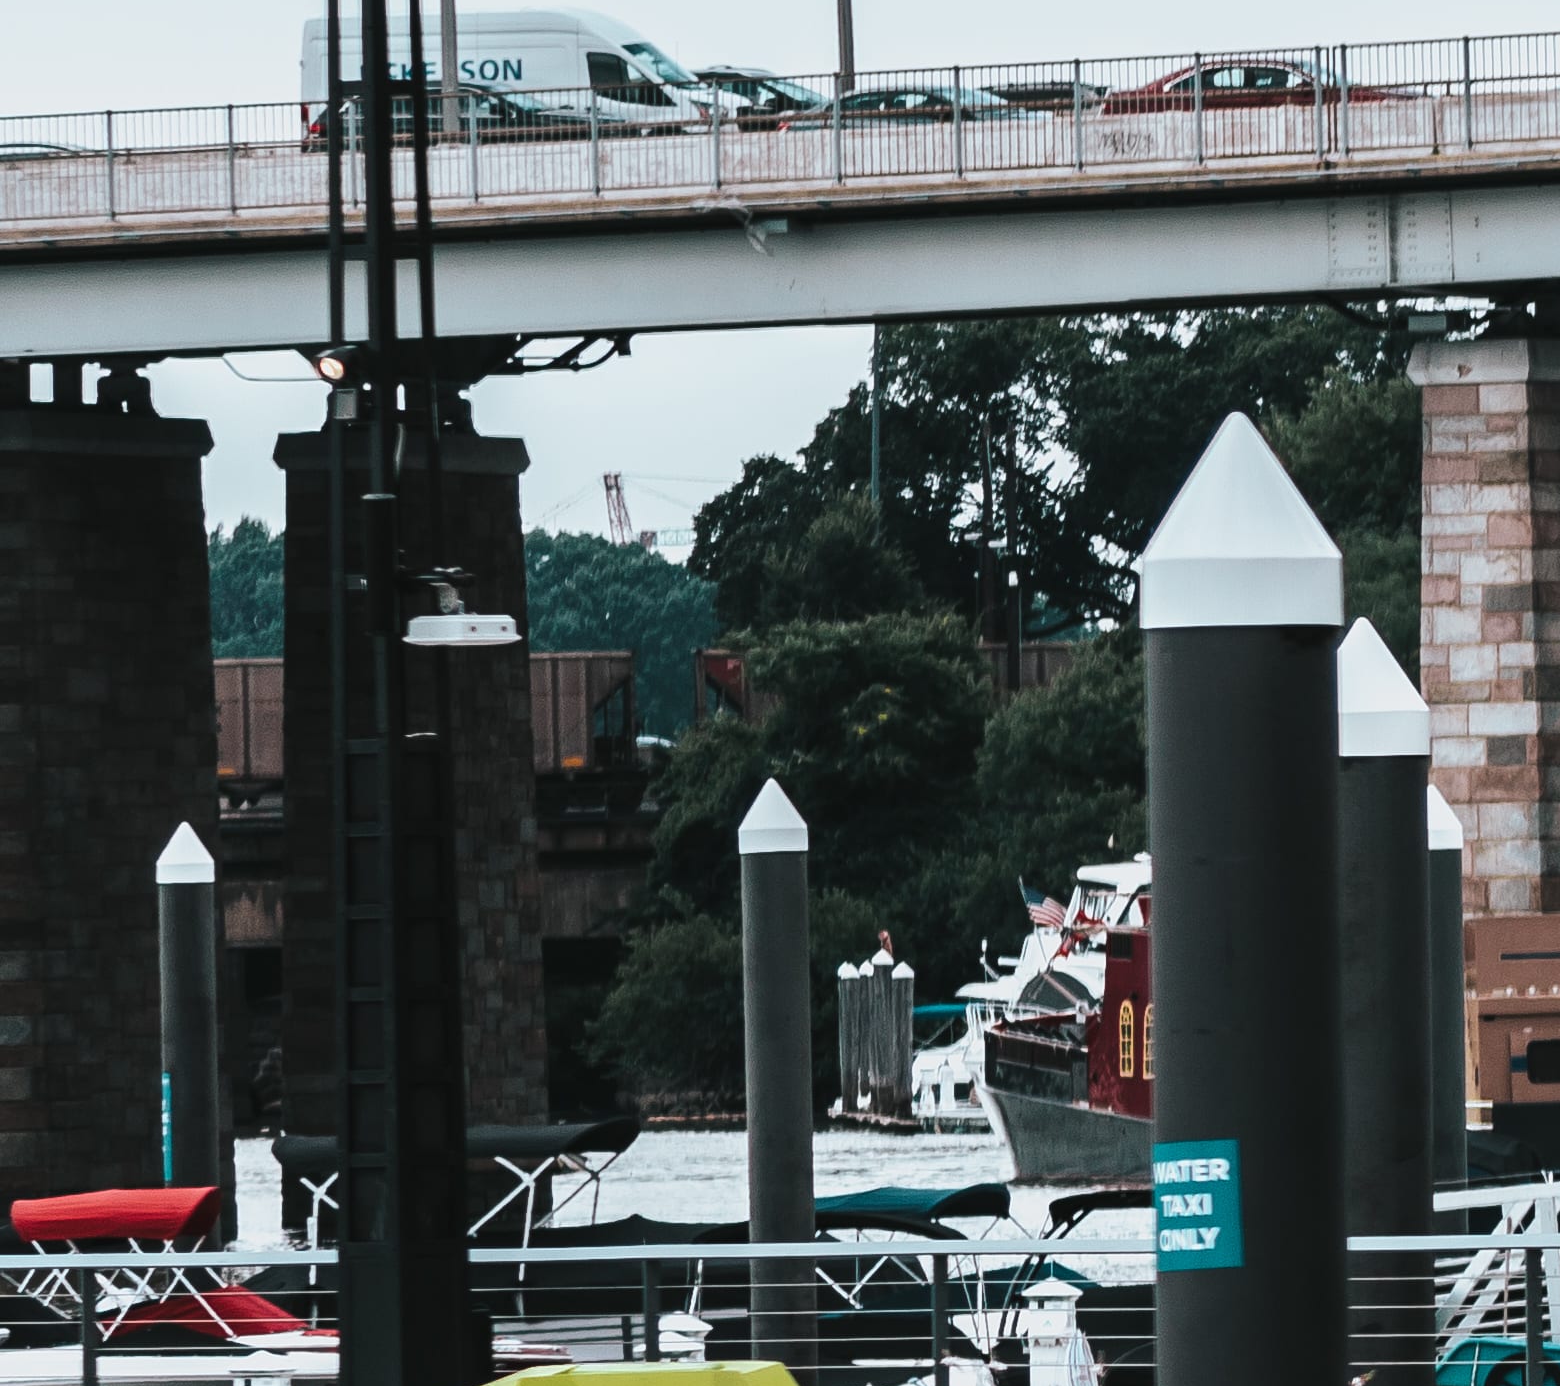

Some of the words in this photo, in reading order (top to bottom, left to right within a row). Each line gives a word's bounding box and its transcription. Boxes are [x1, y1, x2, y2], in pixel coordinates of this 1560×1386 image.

[1152, 1158, 1231, 1184] WATER
[1160, 1193, 1213, 1217] TAXI
[1160, 1226, 1221, 1252] ONLY
